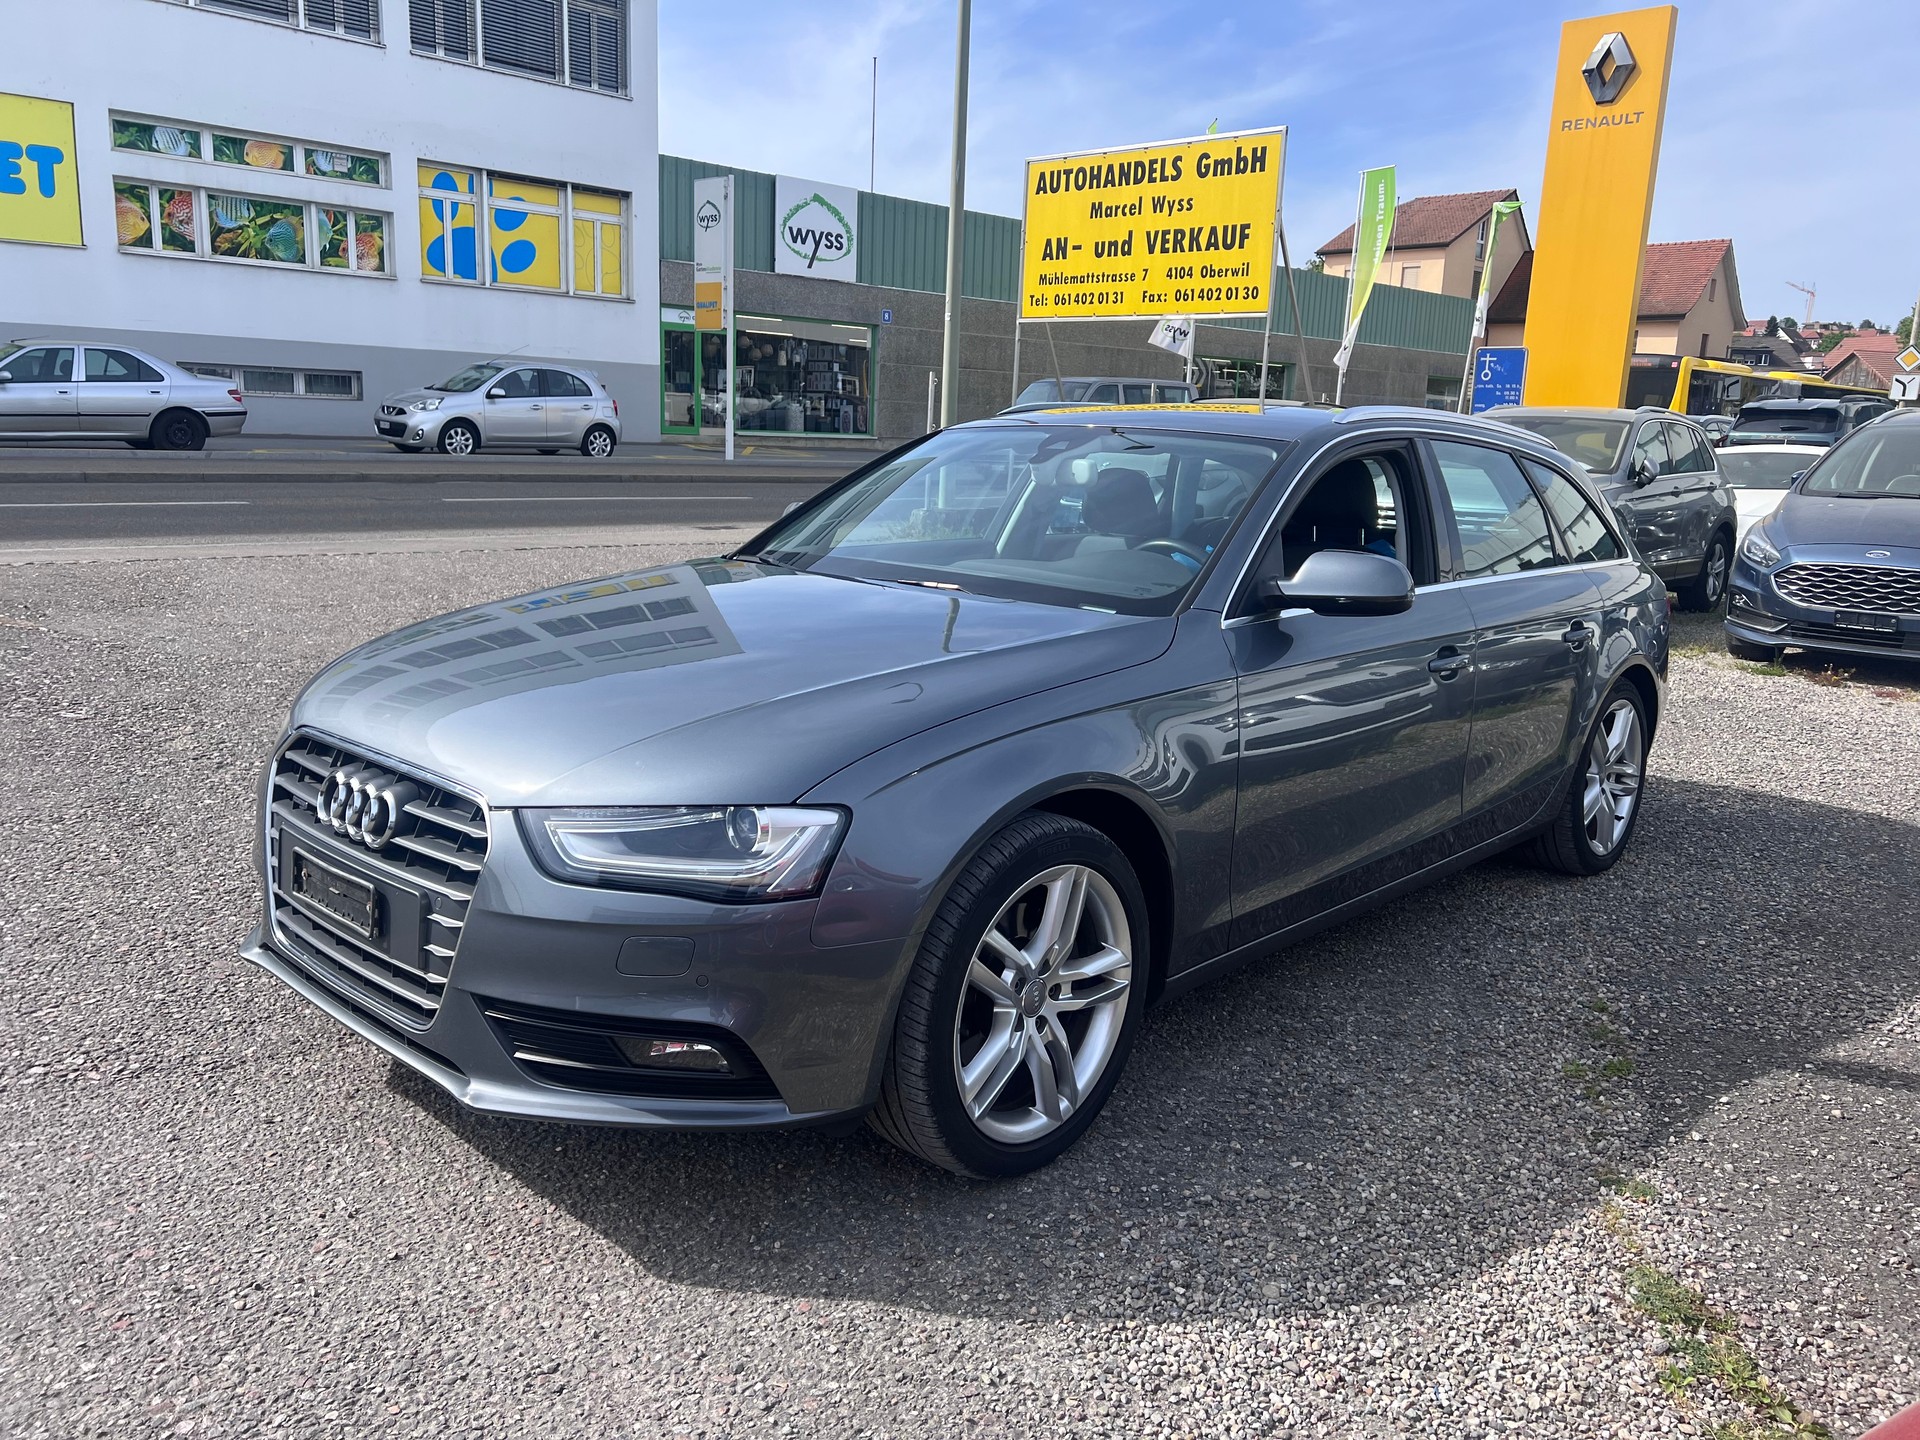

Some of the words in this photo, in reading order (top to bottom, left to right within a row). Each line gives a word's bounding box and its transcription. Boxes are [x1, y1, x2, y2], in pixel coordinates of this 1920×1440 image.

[1561, 112, 1645, 132] RENAULT
[1035, 155, 1183, 195] AUTOHANDELS
[1196, 146, 1268, 179] GmbH
[1090, 196, 1143, 219] Marcel
[1152, 195, 1194, 217] Wyss
[1375, 179, 1385, 221] Traum.
[698, 214, 718, 232] wyss
[787, 226, 845, 269] wyss
[1041, 237, 1083, 261] AN-
[1094, 230, 1134, 259] und
[1145, 223, 1252, 255] VERKAUF
[1038, 271, 1137, 286] Mühlemattstrasse
[1141, 268, 1149, 282] 7
[1165, 266, 1194, 280] 4104
[1200, 262, 1250, 279] Oberwil
[1029, 293, 1048, 307] Tel:
[1142, 290, 1168, 303] Fax:
[884, 312, 889, 320] 8
